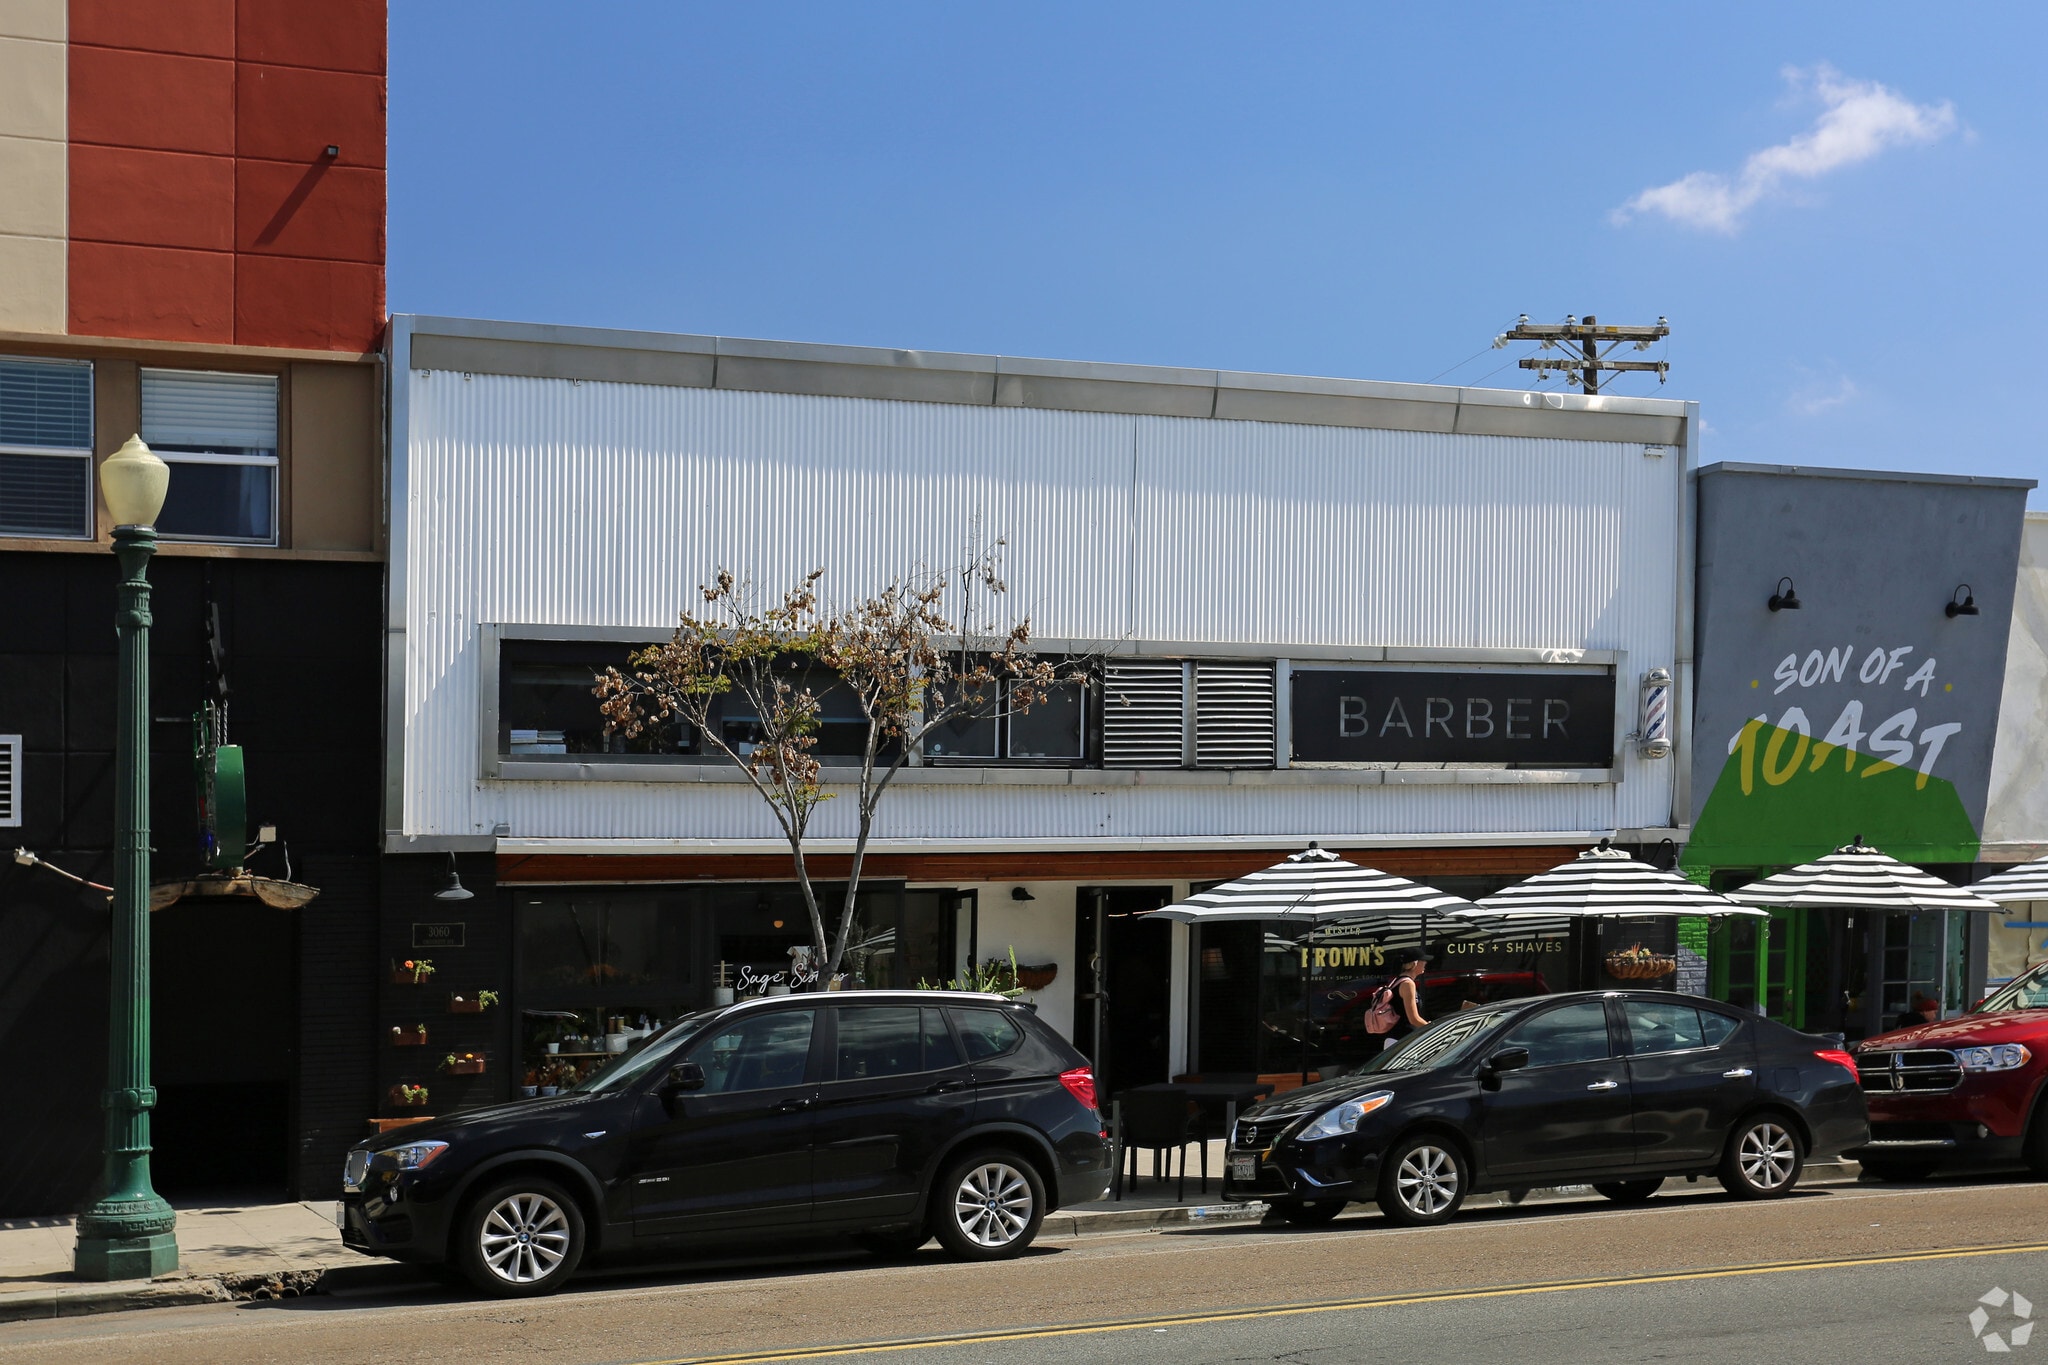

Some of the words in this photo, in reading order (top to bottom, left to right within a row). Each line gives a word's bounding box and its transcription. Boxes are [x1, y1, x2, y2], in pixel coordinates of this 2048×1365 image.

[1774, 645, 1853, 695] SON
[1859, 646, 1914, 684] OF
[1904, 658, 1936, 697] A
[1338, 696, 1571, 740] BARBER
[1728, 700, 1962, 796] TOAST
[1447, 943, 1485, 954] CUTS
[1506, 941, 1562, 953] SHAVES
[737, 965, 784, 994] Sage
